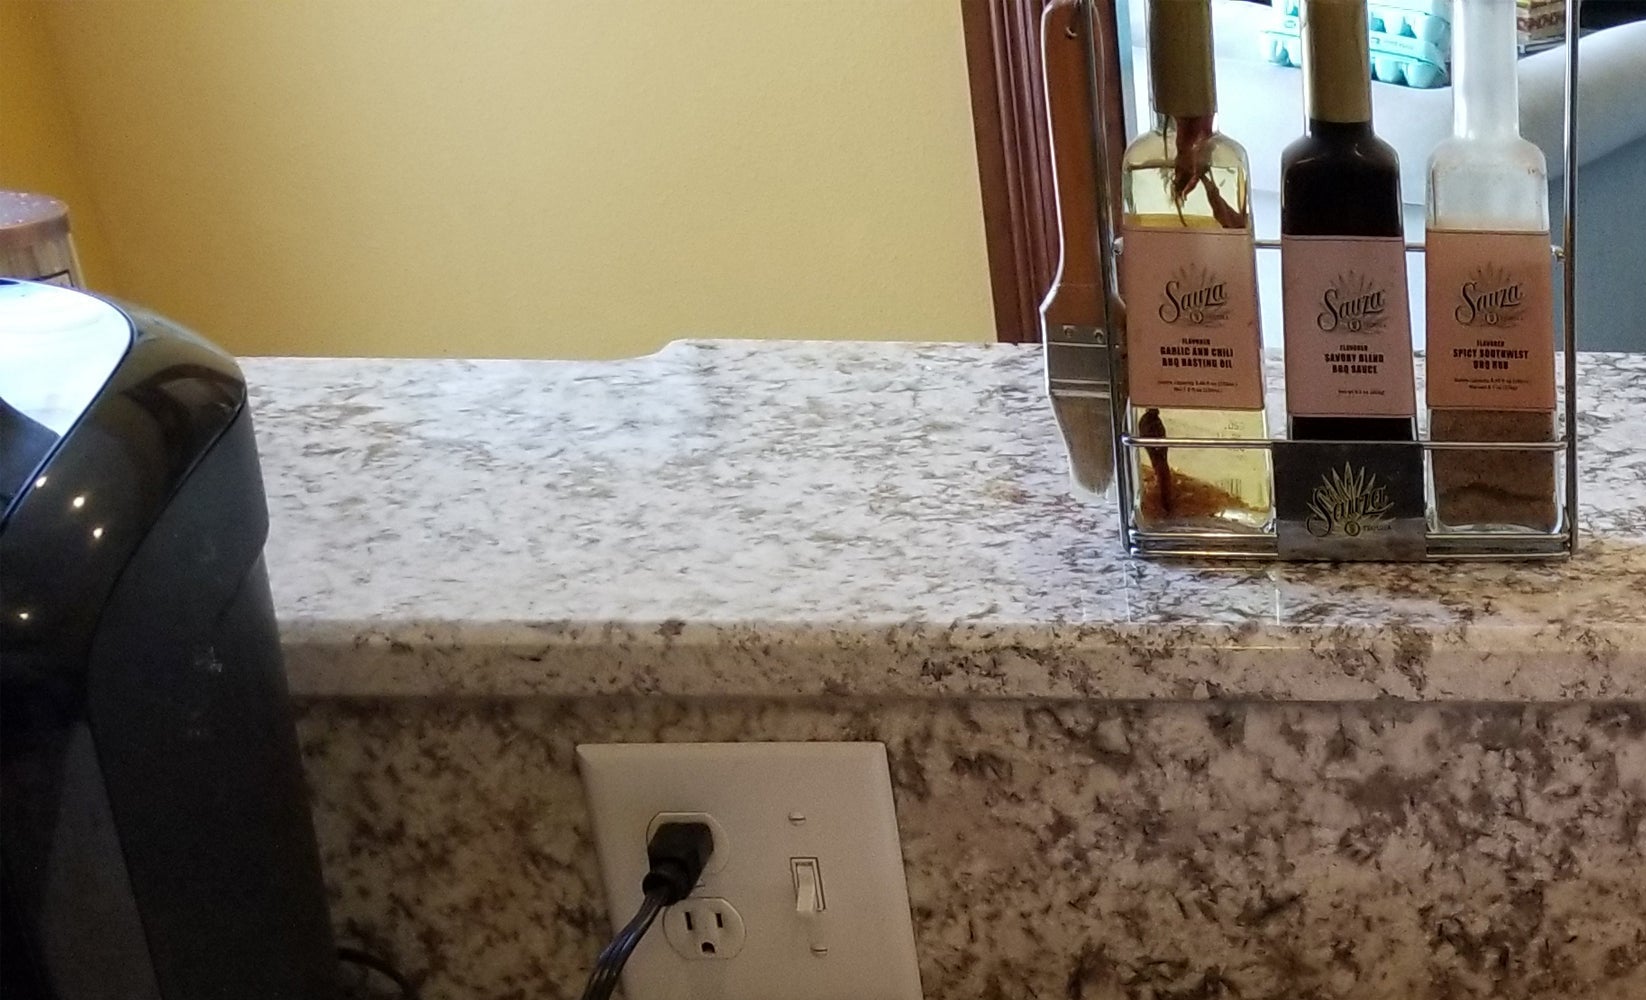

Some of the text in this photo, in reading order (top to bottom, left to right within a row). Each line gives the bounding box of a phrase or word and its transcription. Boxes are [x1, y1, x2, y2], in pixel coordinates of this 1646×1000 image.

[1159, 281, 1227, 324] Sauza
[1455, 282, 1522, 326] Sauza
[1317, 288, 1385, 332] Sauza
[1160, 346, 1234, 358] GARLIC AND CHILI
[1324, 353, 1384, 363] SAVORY BLEND
[1453, 348, 1529, 359] SPICY SOUTHWEST
[1181, 358, 1218, 368] BASTING
[1219, 359, 1233, 369] OIL
[1332, 364, 1378, 374] BBQ SAUCE
[1306, 487, 1393, 538] Sauza
